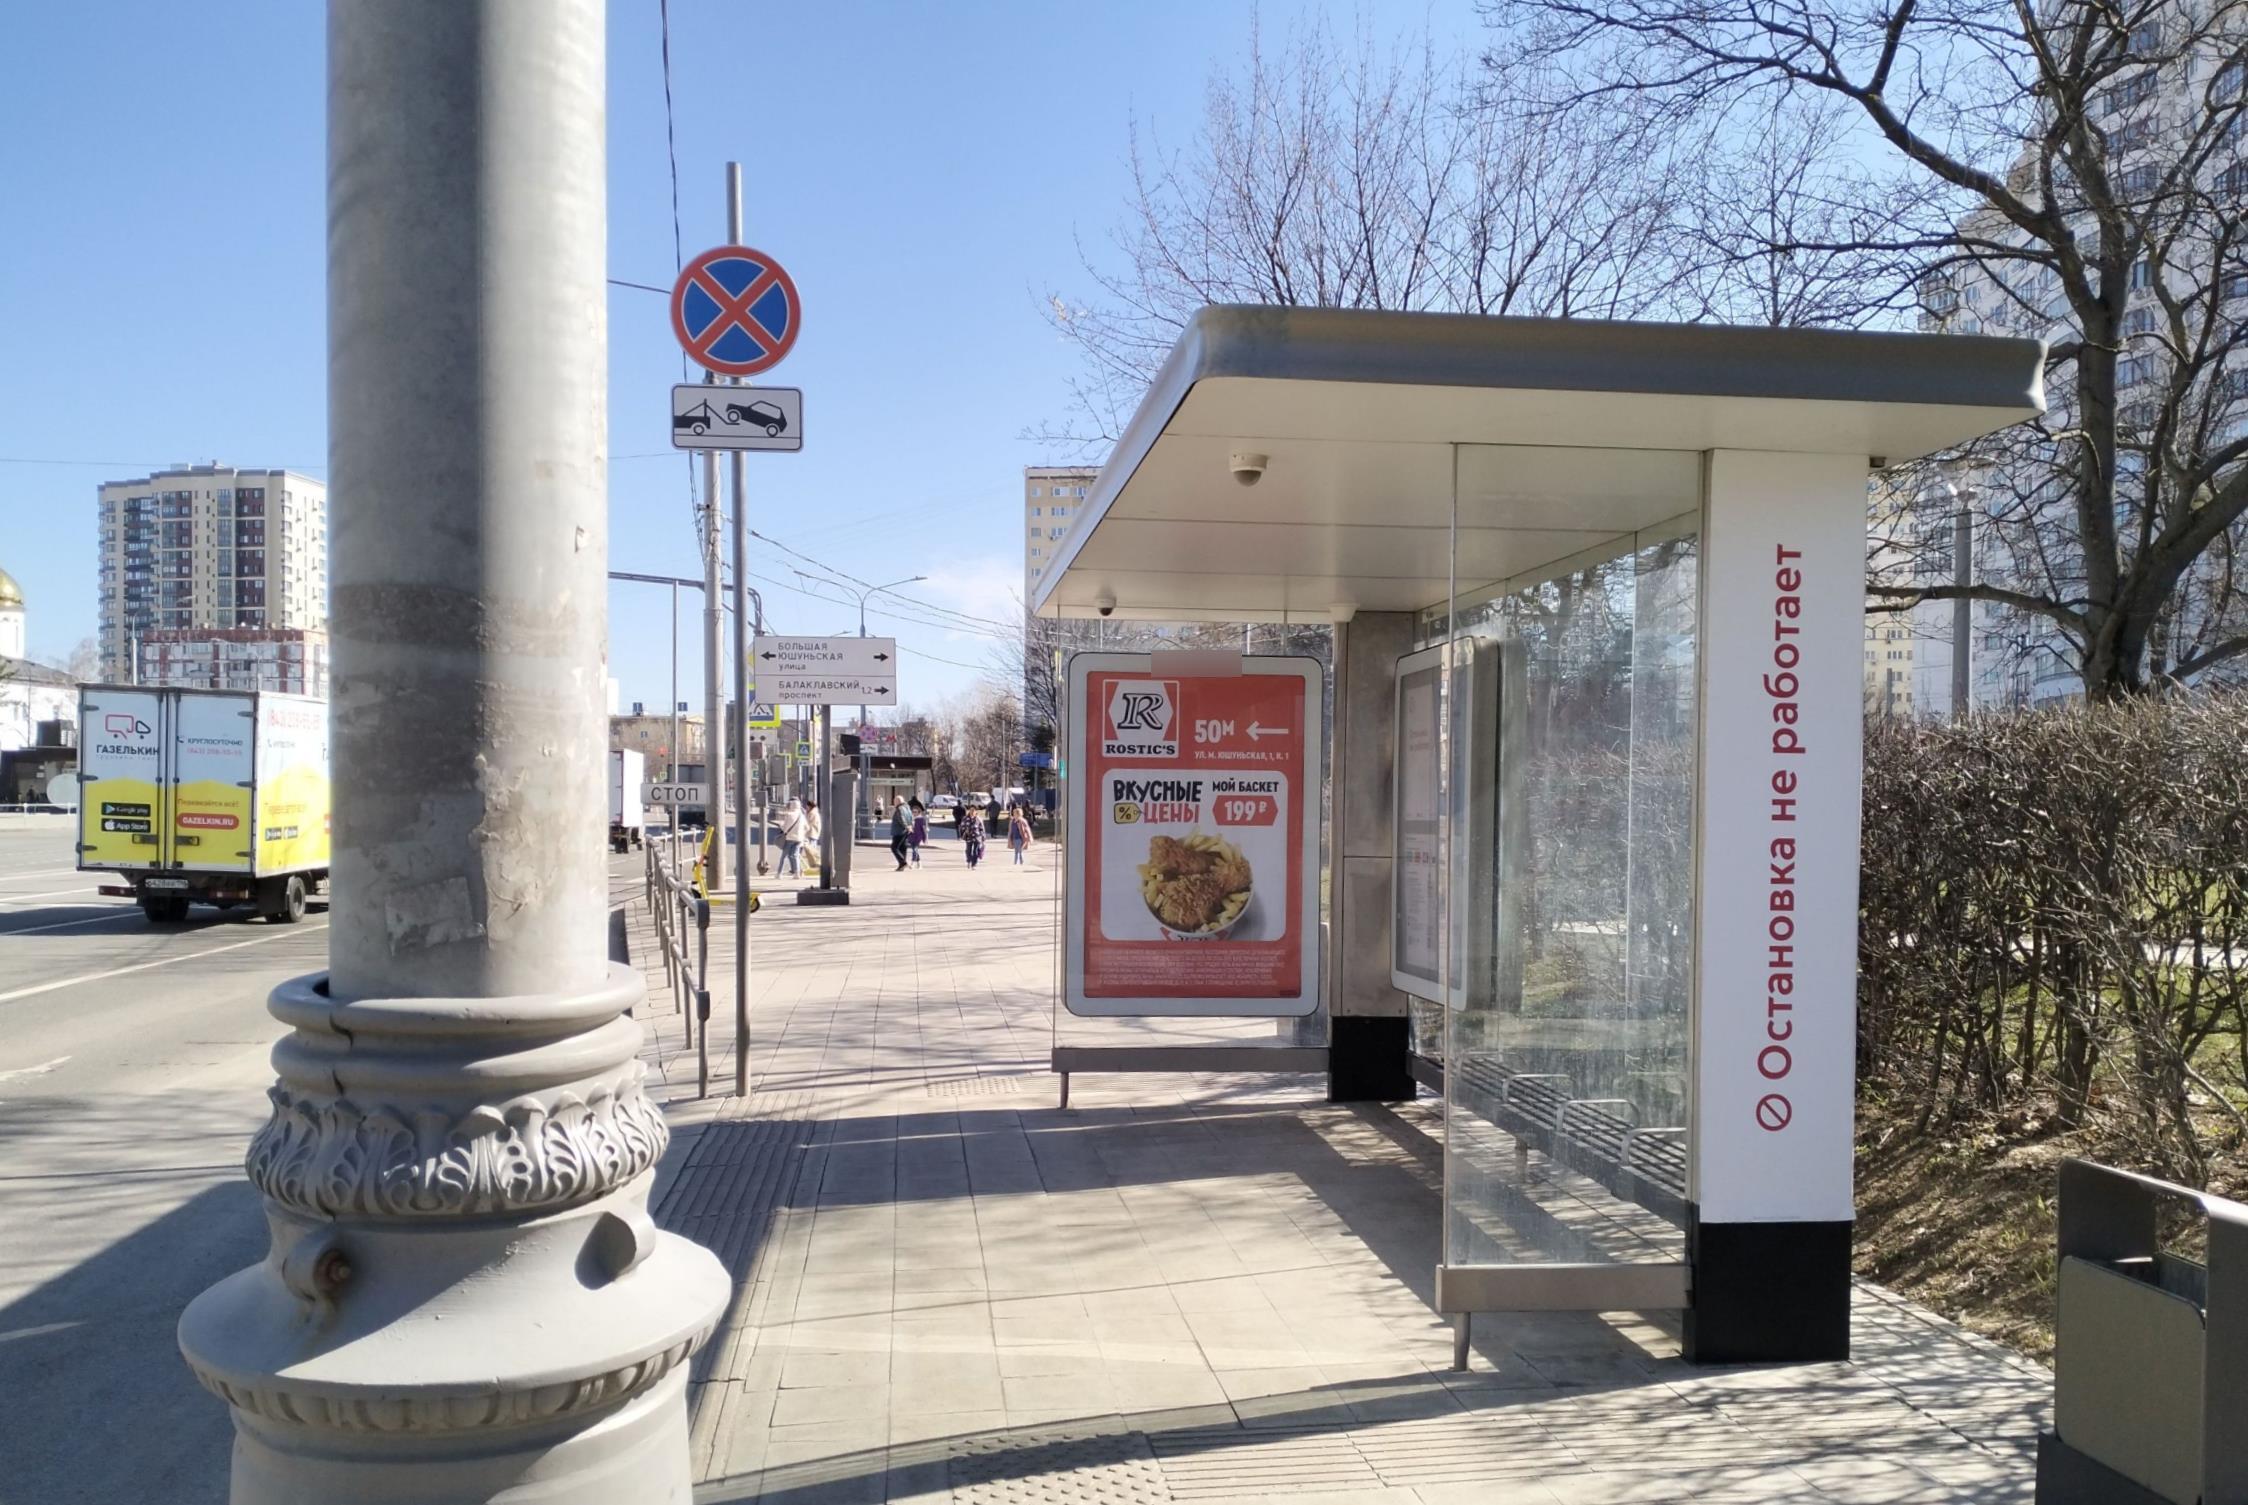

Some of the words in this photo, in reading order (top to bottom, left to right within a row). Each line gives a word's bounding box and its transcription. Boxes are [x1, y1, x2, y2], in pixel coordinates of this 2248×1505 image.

[777, 642, 828, 651] БОЛЬШАЯ
[1763, 543, 1806, 755] работает
[778, 652, 844, 661] ЮШУНЬСКАЯ
[778, 680, 860, 689] БАЛАКЛАВСКИЙ
[778, 692, 822, 700] проспект
[1117, 693, 1164, 730] R
[96, 744, 160, 756] ГАЗЕЛЬКИН
[1105, 744, 1176, 755] ROSTIC'S
[1113, 779, 1203, 803] ВКУСНЫЕ
[1212, 777, 1236, 792] МОЙ
[1238, 781, 1279, 793] БАСКЕТ
[651, 787, 698, 801] СТОП
[1771, 769, 1797, 822] не
[1143, 802, 1199, 824] ЦЕНЫ
[182, 816, 234, 826] GAZELKIN.RU
[1756, 836, 1797, 1080] Остановка
